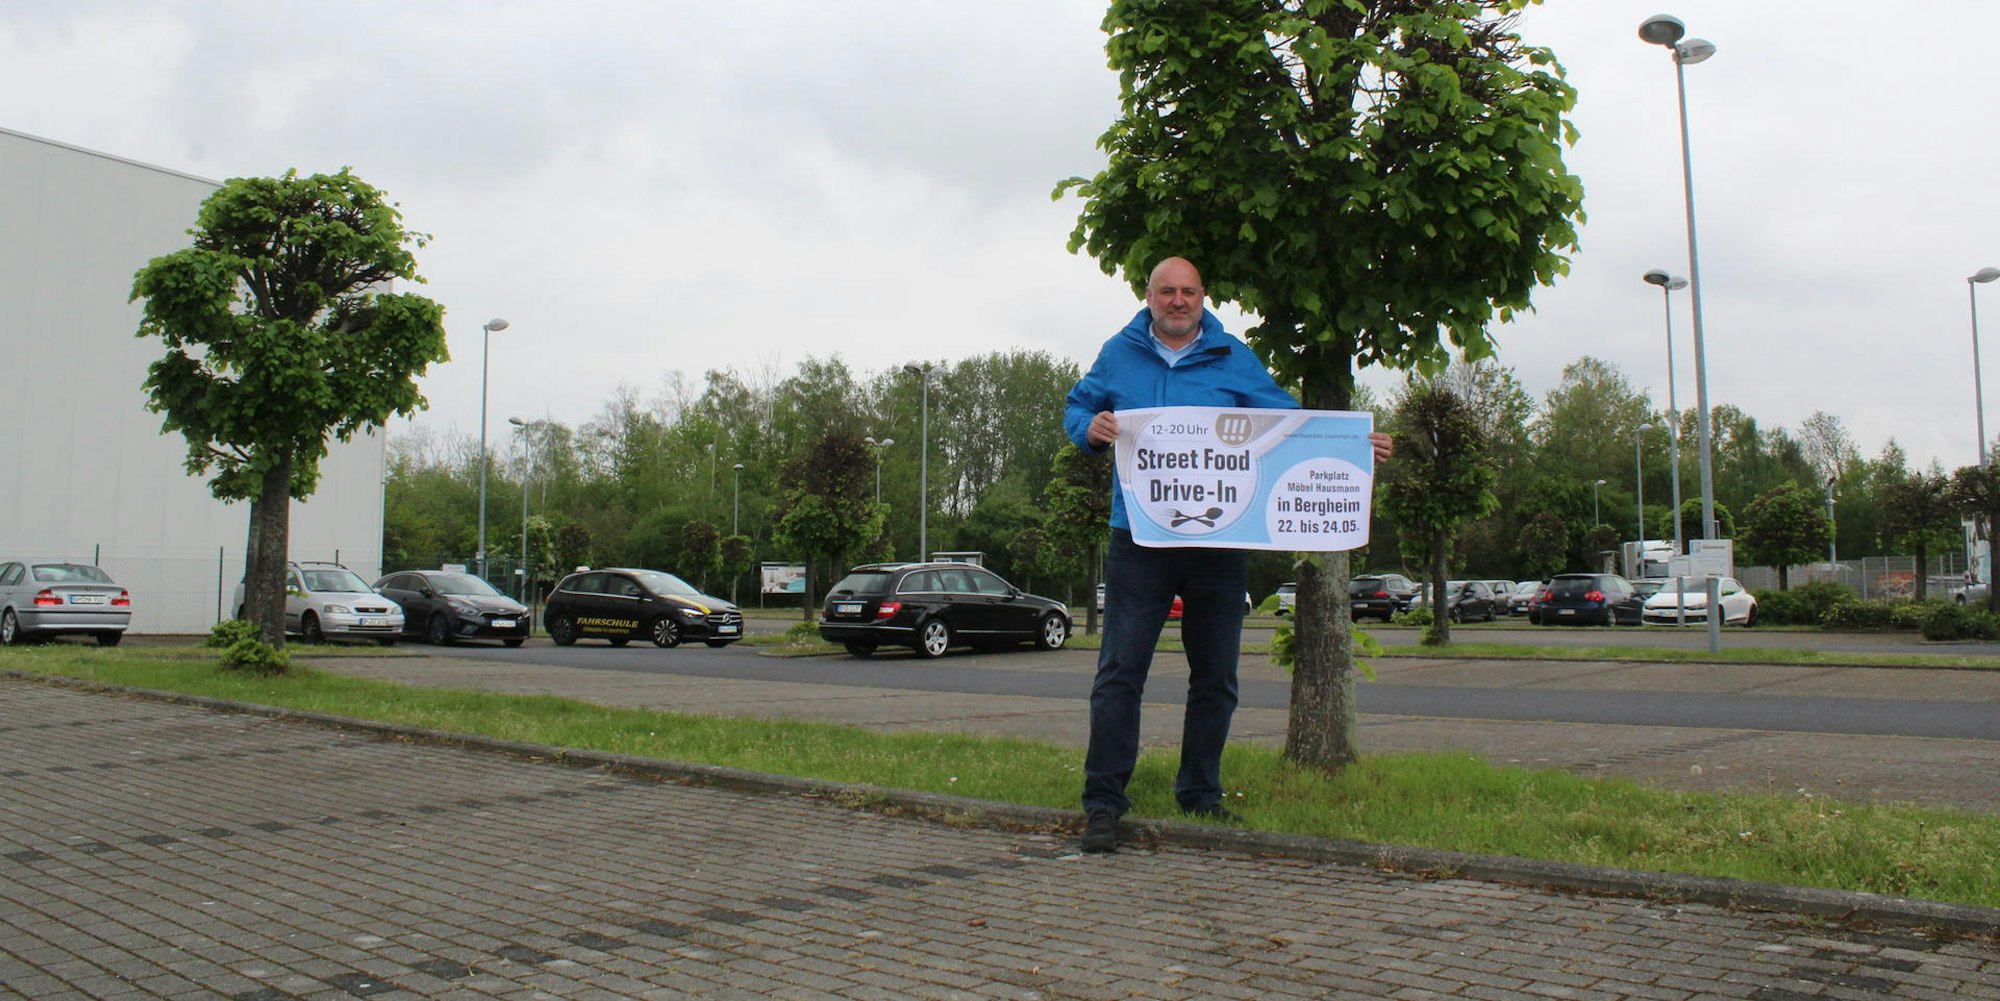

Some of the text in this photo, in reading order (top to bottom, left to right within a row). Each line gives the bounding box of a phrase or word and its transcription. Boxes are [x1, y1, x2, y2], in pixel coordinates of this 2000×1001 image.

[1187, 424, 1209, 435] Uhr
[1137, 448, 1250, 471] Street Food
[1309, 470, 1350, 482] Parkplatz
[1150, 478, 1237, 503] Drive-In
[1287, 482, 1360, 493] Möbel Hausmann
[1277, 497, 1360, 516] in Bergheim
[1278, 519, 1360, 533] 22. bis 24.05.
[576, 617, 639, 628] FAHRSCHULE
